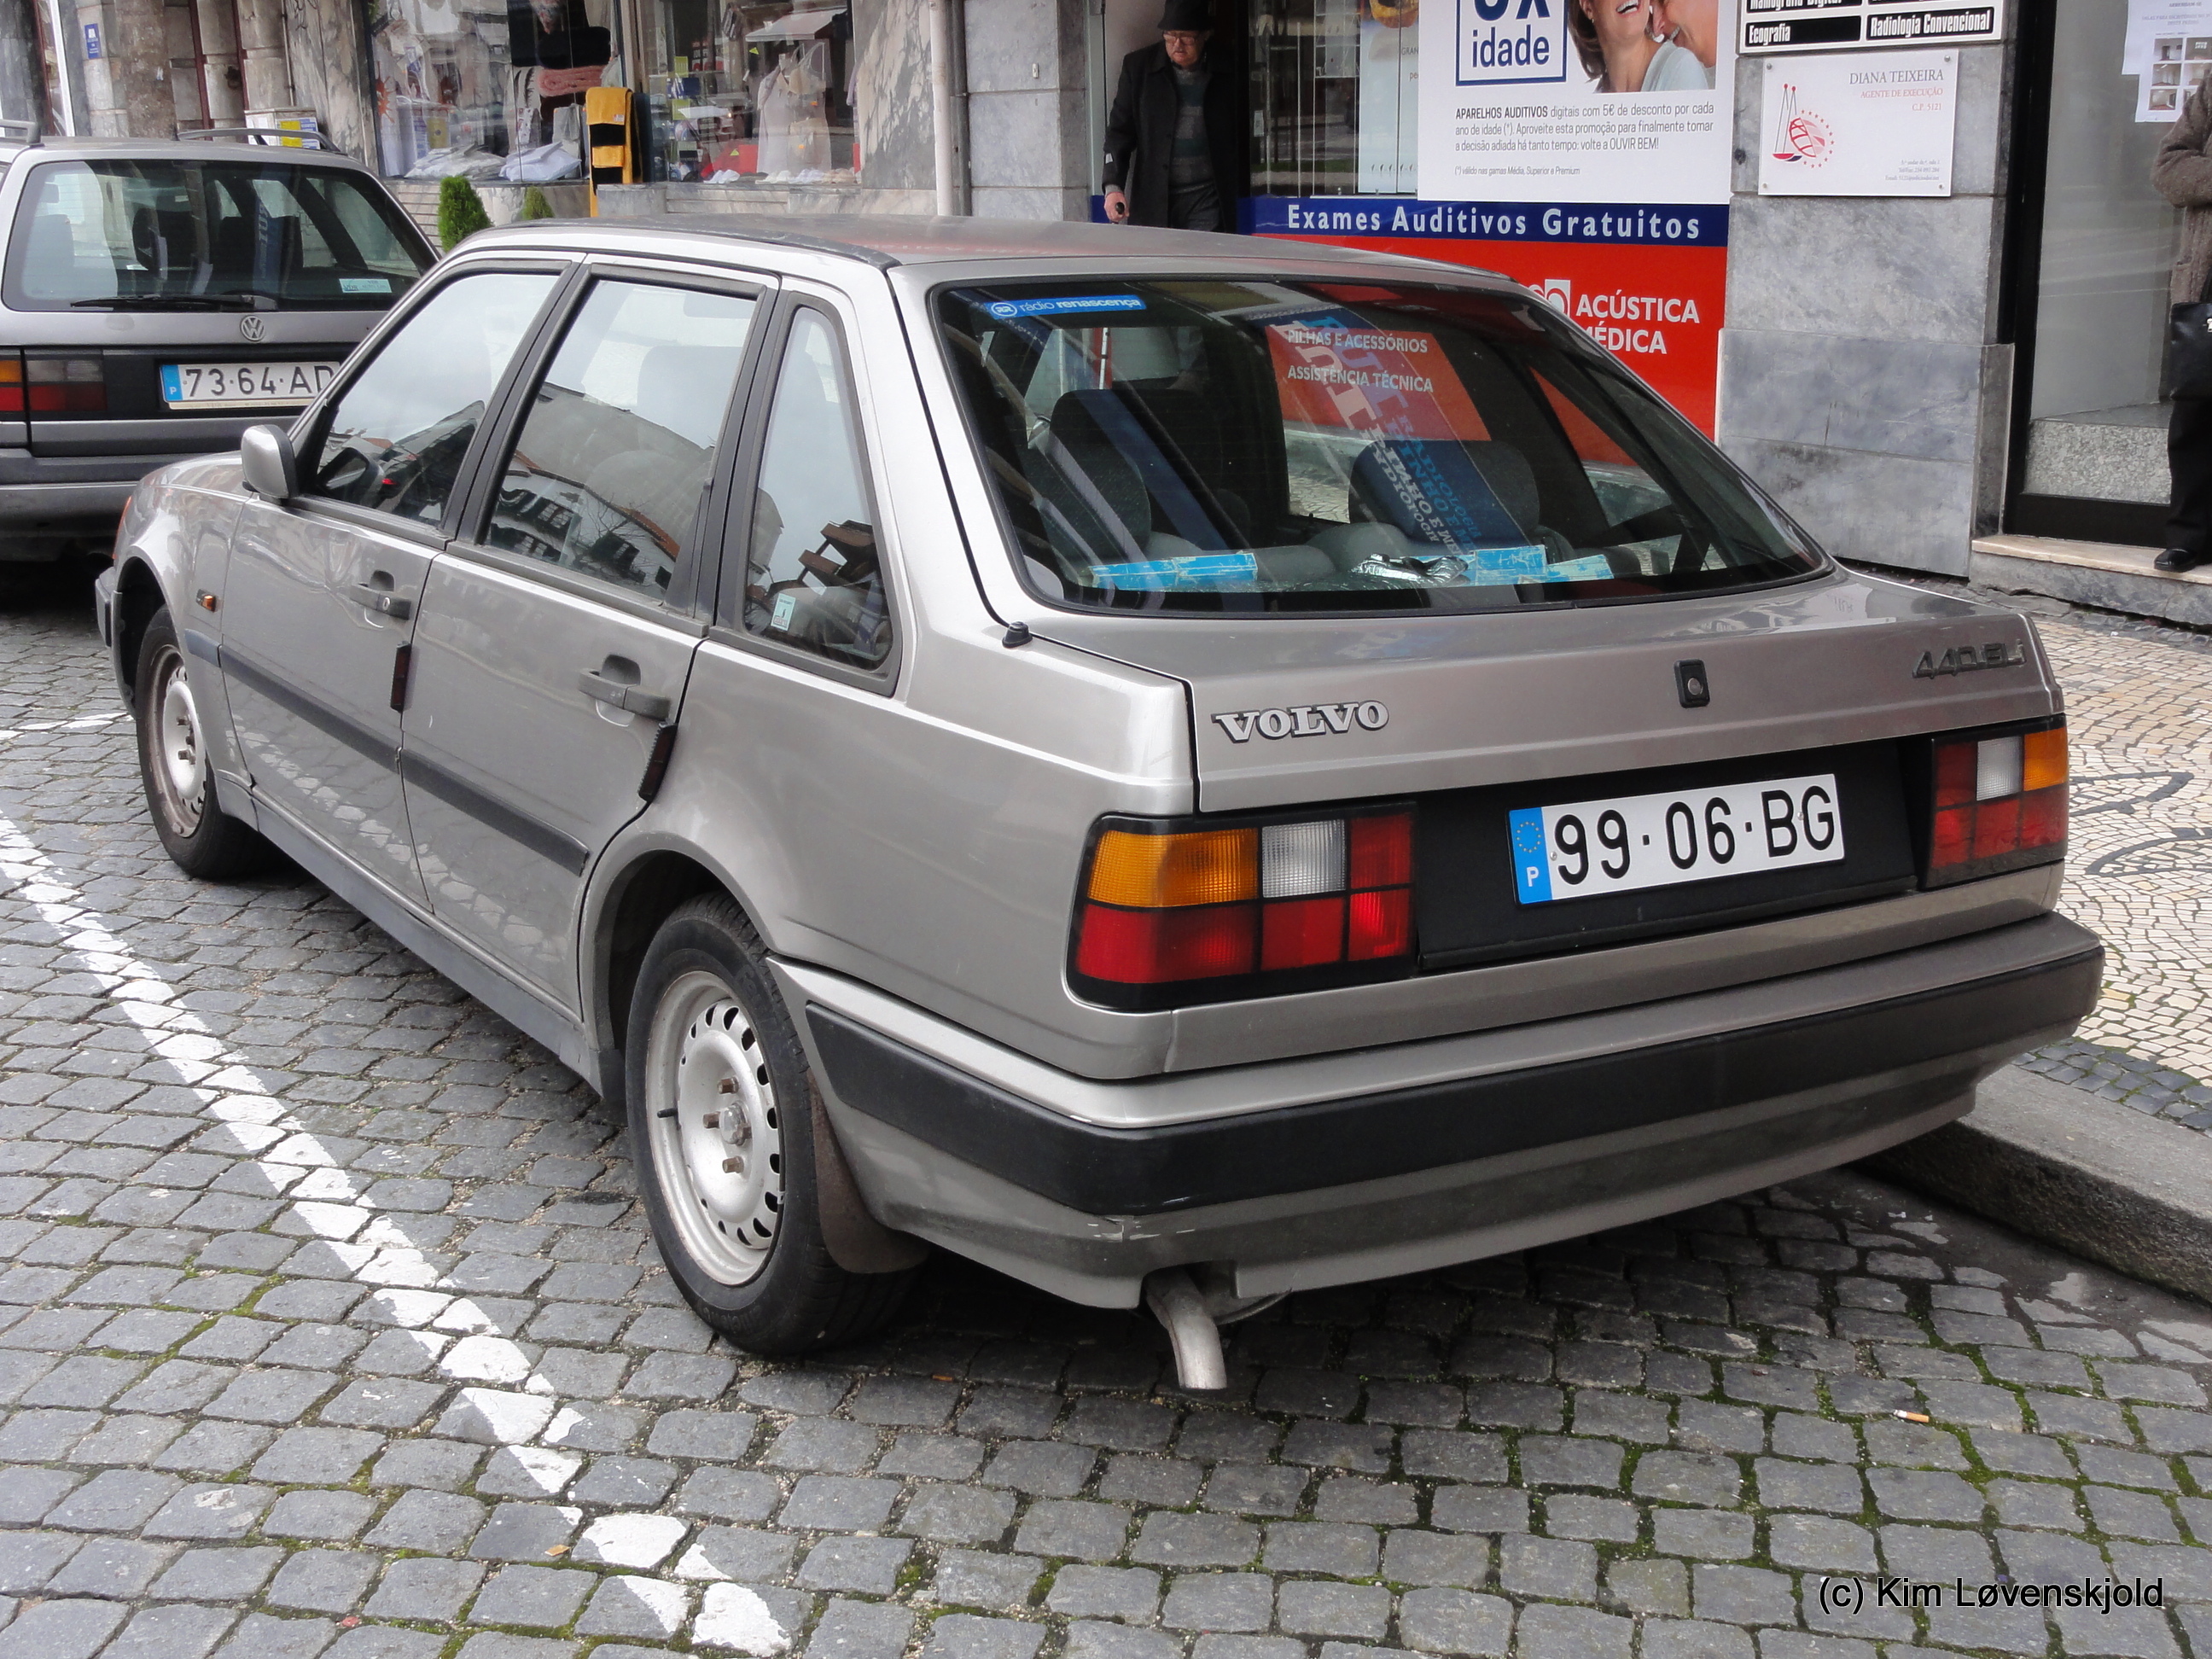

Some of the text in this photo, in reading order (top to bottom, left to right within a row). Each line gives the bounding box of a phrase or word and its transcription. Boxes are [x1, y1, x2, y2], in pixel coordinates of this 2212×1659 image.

[1749, 23, 1791, 45] Ecografia
[1870, 9, 1991, 38] Radiologia Convencional
[1472, 24, 1550, 67] idade
[1849, 69, 1944, 84] DIANA TEIXEIRA
[1903, 87, 1943, 97] EXECUÇÃO
[1456, 102, 1714, 119] APARELHOS AUDITIVOS digitais com 5€ de desconto por cada
[1455, 126, 1469, 136] ano
[1470, 124, 1480, 136] de
[1481, 124, 1502, 136] idade
[1516, 122, 1554, 137] Aproveite
[1556, 124, 1574, 134] esta
[1575, 121, 1616, 136] promoção
[1618, 124, 1637, 135] para
[1639, 119, 1685, 132] finalmente
[1687, 121, 1714, 132] tomar
[1455, 137, 1659, 152] a decisão adiada há tanto tempo: volte a OUVIR BEM!
[1288, 205, 1700, 239] Exames Auditivos Gratuitos
[1020, 301, 1055, 313] rádio
[1057, 298, 1141, 308] renascença
[1576, 289, 1700, 323] ACÚSTICA
[1288, 329, 1428, 352] PILHAS E ACESSÓRIOS
[1288, 365, 1434, 393] ASSISTÊNCIA TÉCNICA
[170, 387, 178, 395] P
[1211, 700, 1389, 743] VOLVO
[1526, 866, 1540, 888] P
